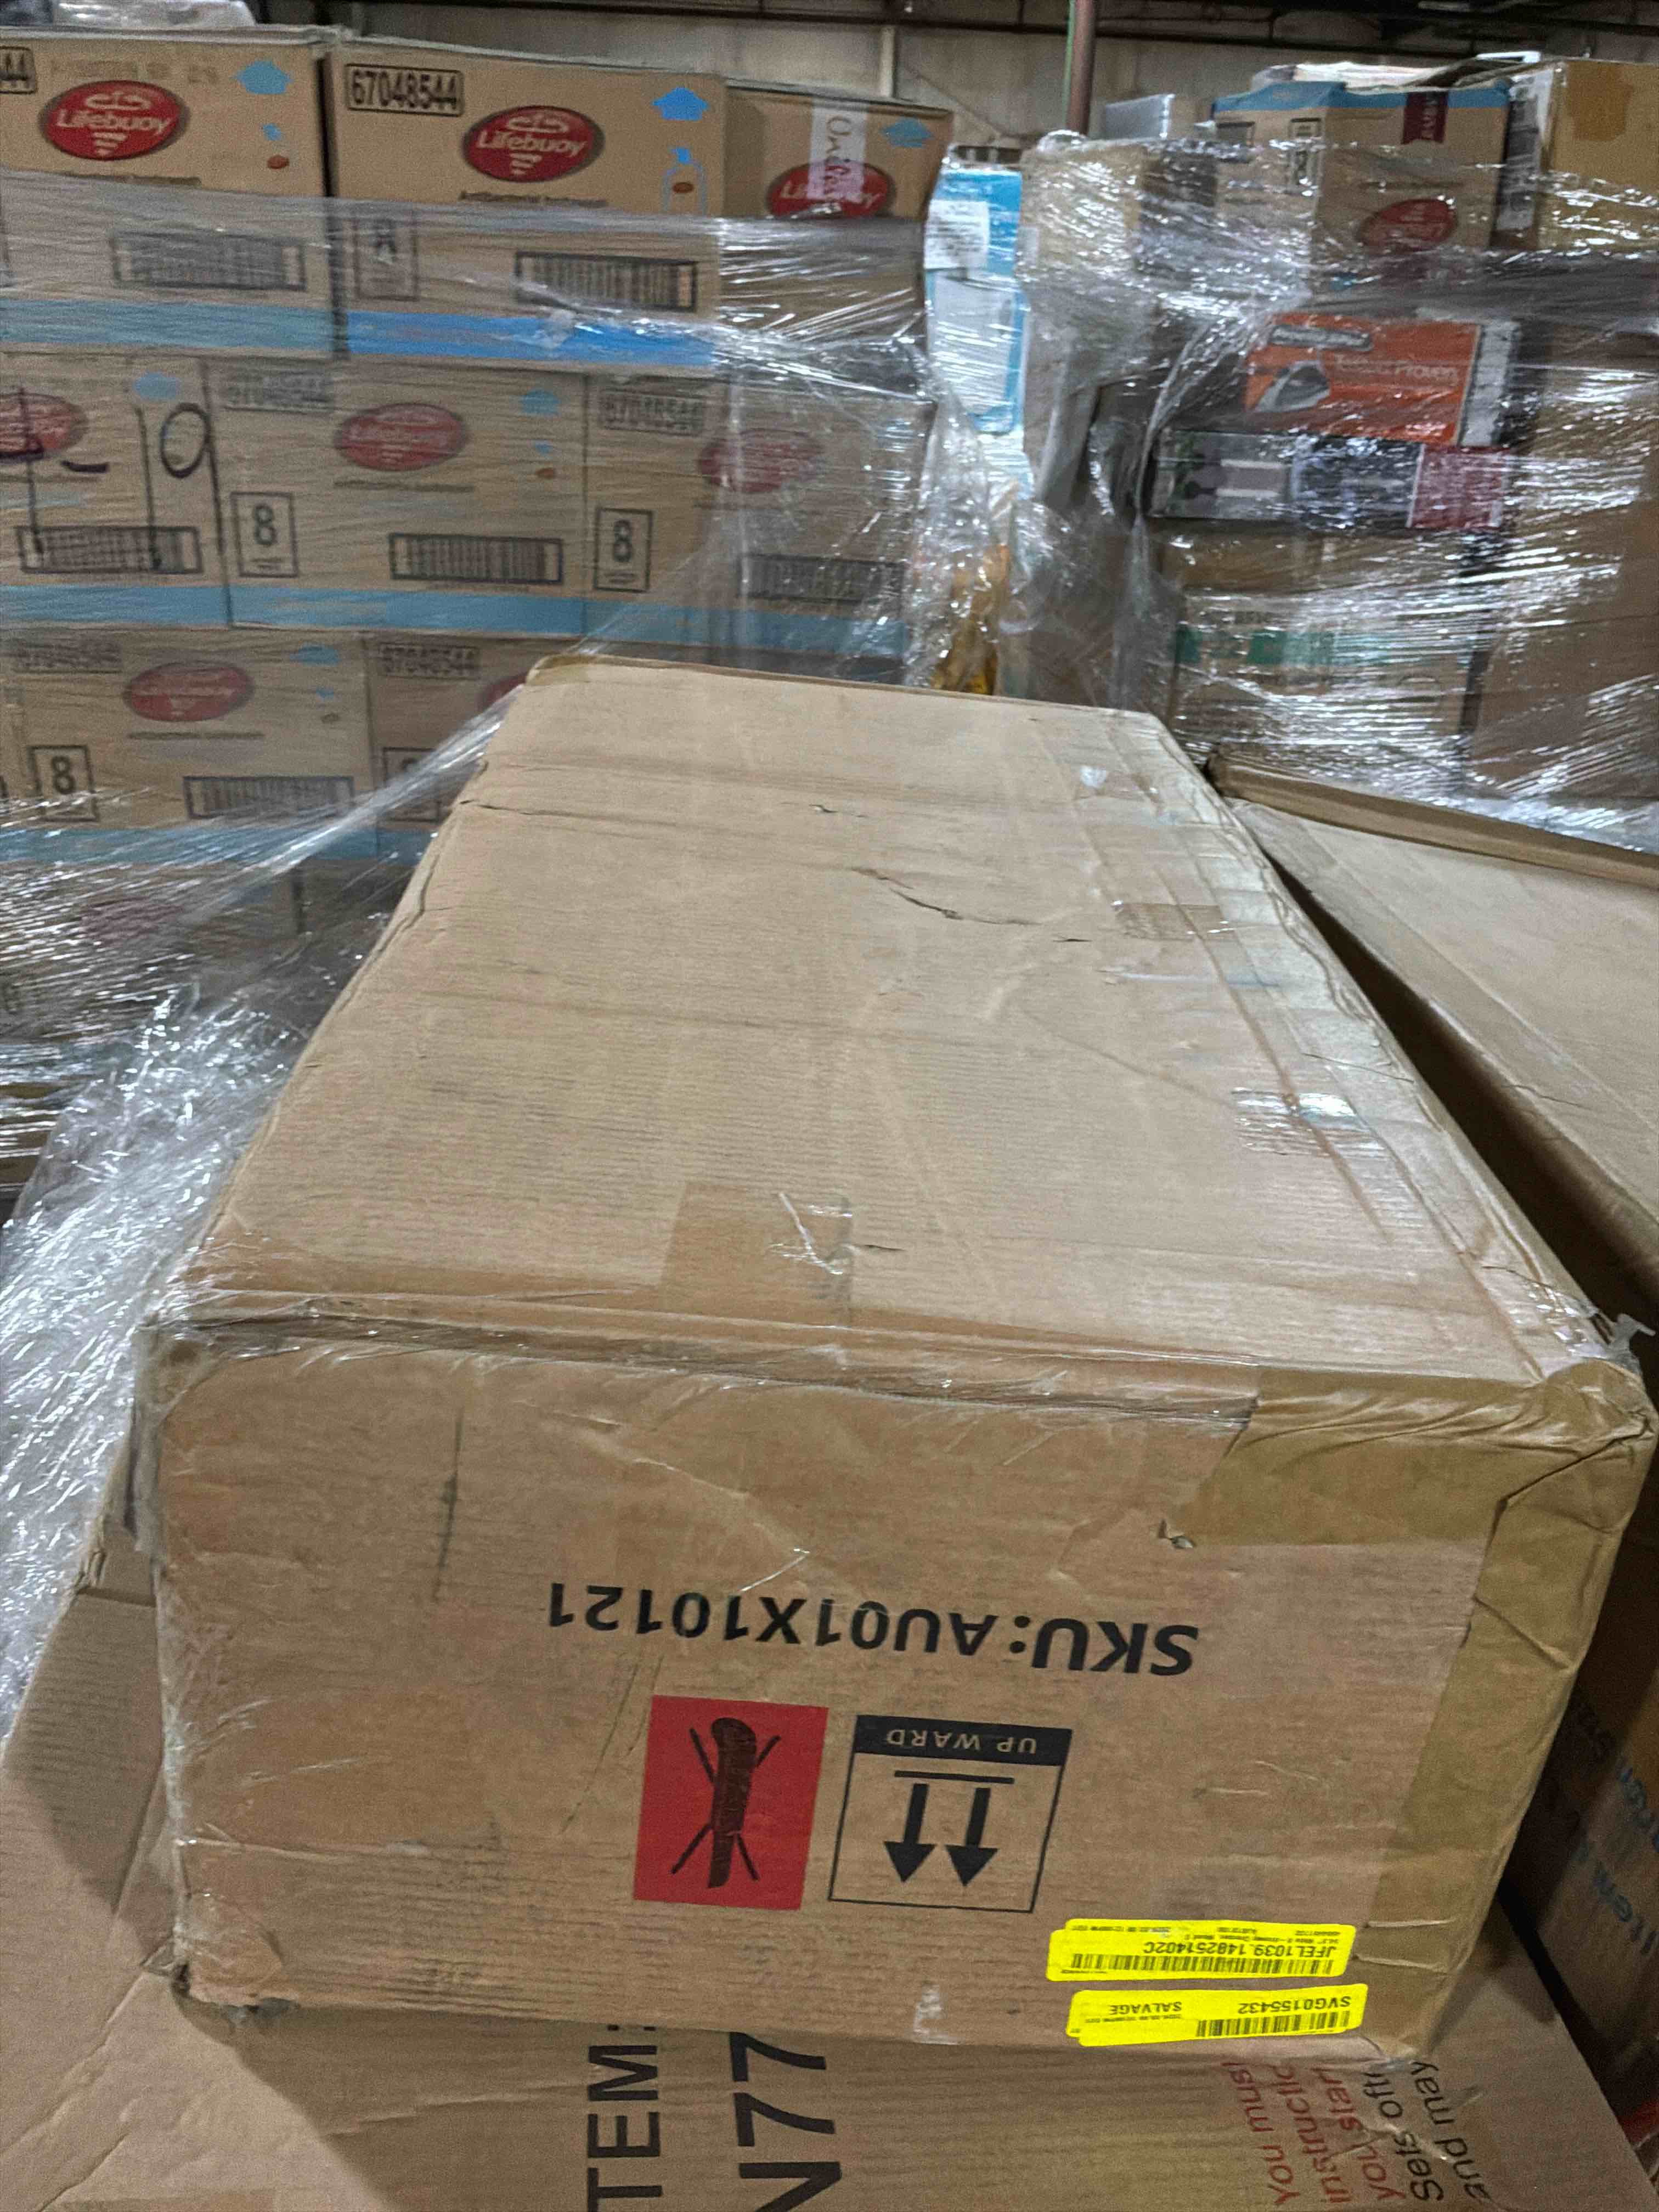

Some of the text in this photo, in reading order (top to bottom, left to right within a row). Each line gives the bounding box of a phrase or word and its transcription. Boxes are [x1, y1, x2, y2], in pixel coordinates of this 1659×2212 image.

[351, 69, 458, 110] 67048544
[57, 109, 172, 135] Lifebuoy
[476, 129, 588, 158] Lifebuoy
[252, 503, 276, 546] 8
[613, 519, 634, 563] 8
[52, 755, 76, 795] 8
[550, 1583, 1198, 1675] SKU:AU01X10121
[887, 1730, 1036, 1753] UP WARD
[1108, 2001, 1182, 2016] SALVAGE
[1409, 2061, 1493, 2201] and may
[1261, 2144, 1301, 2205] You
[1392, 2132, 1444, 2202] Sets
